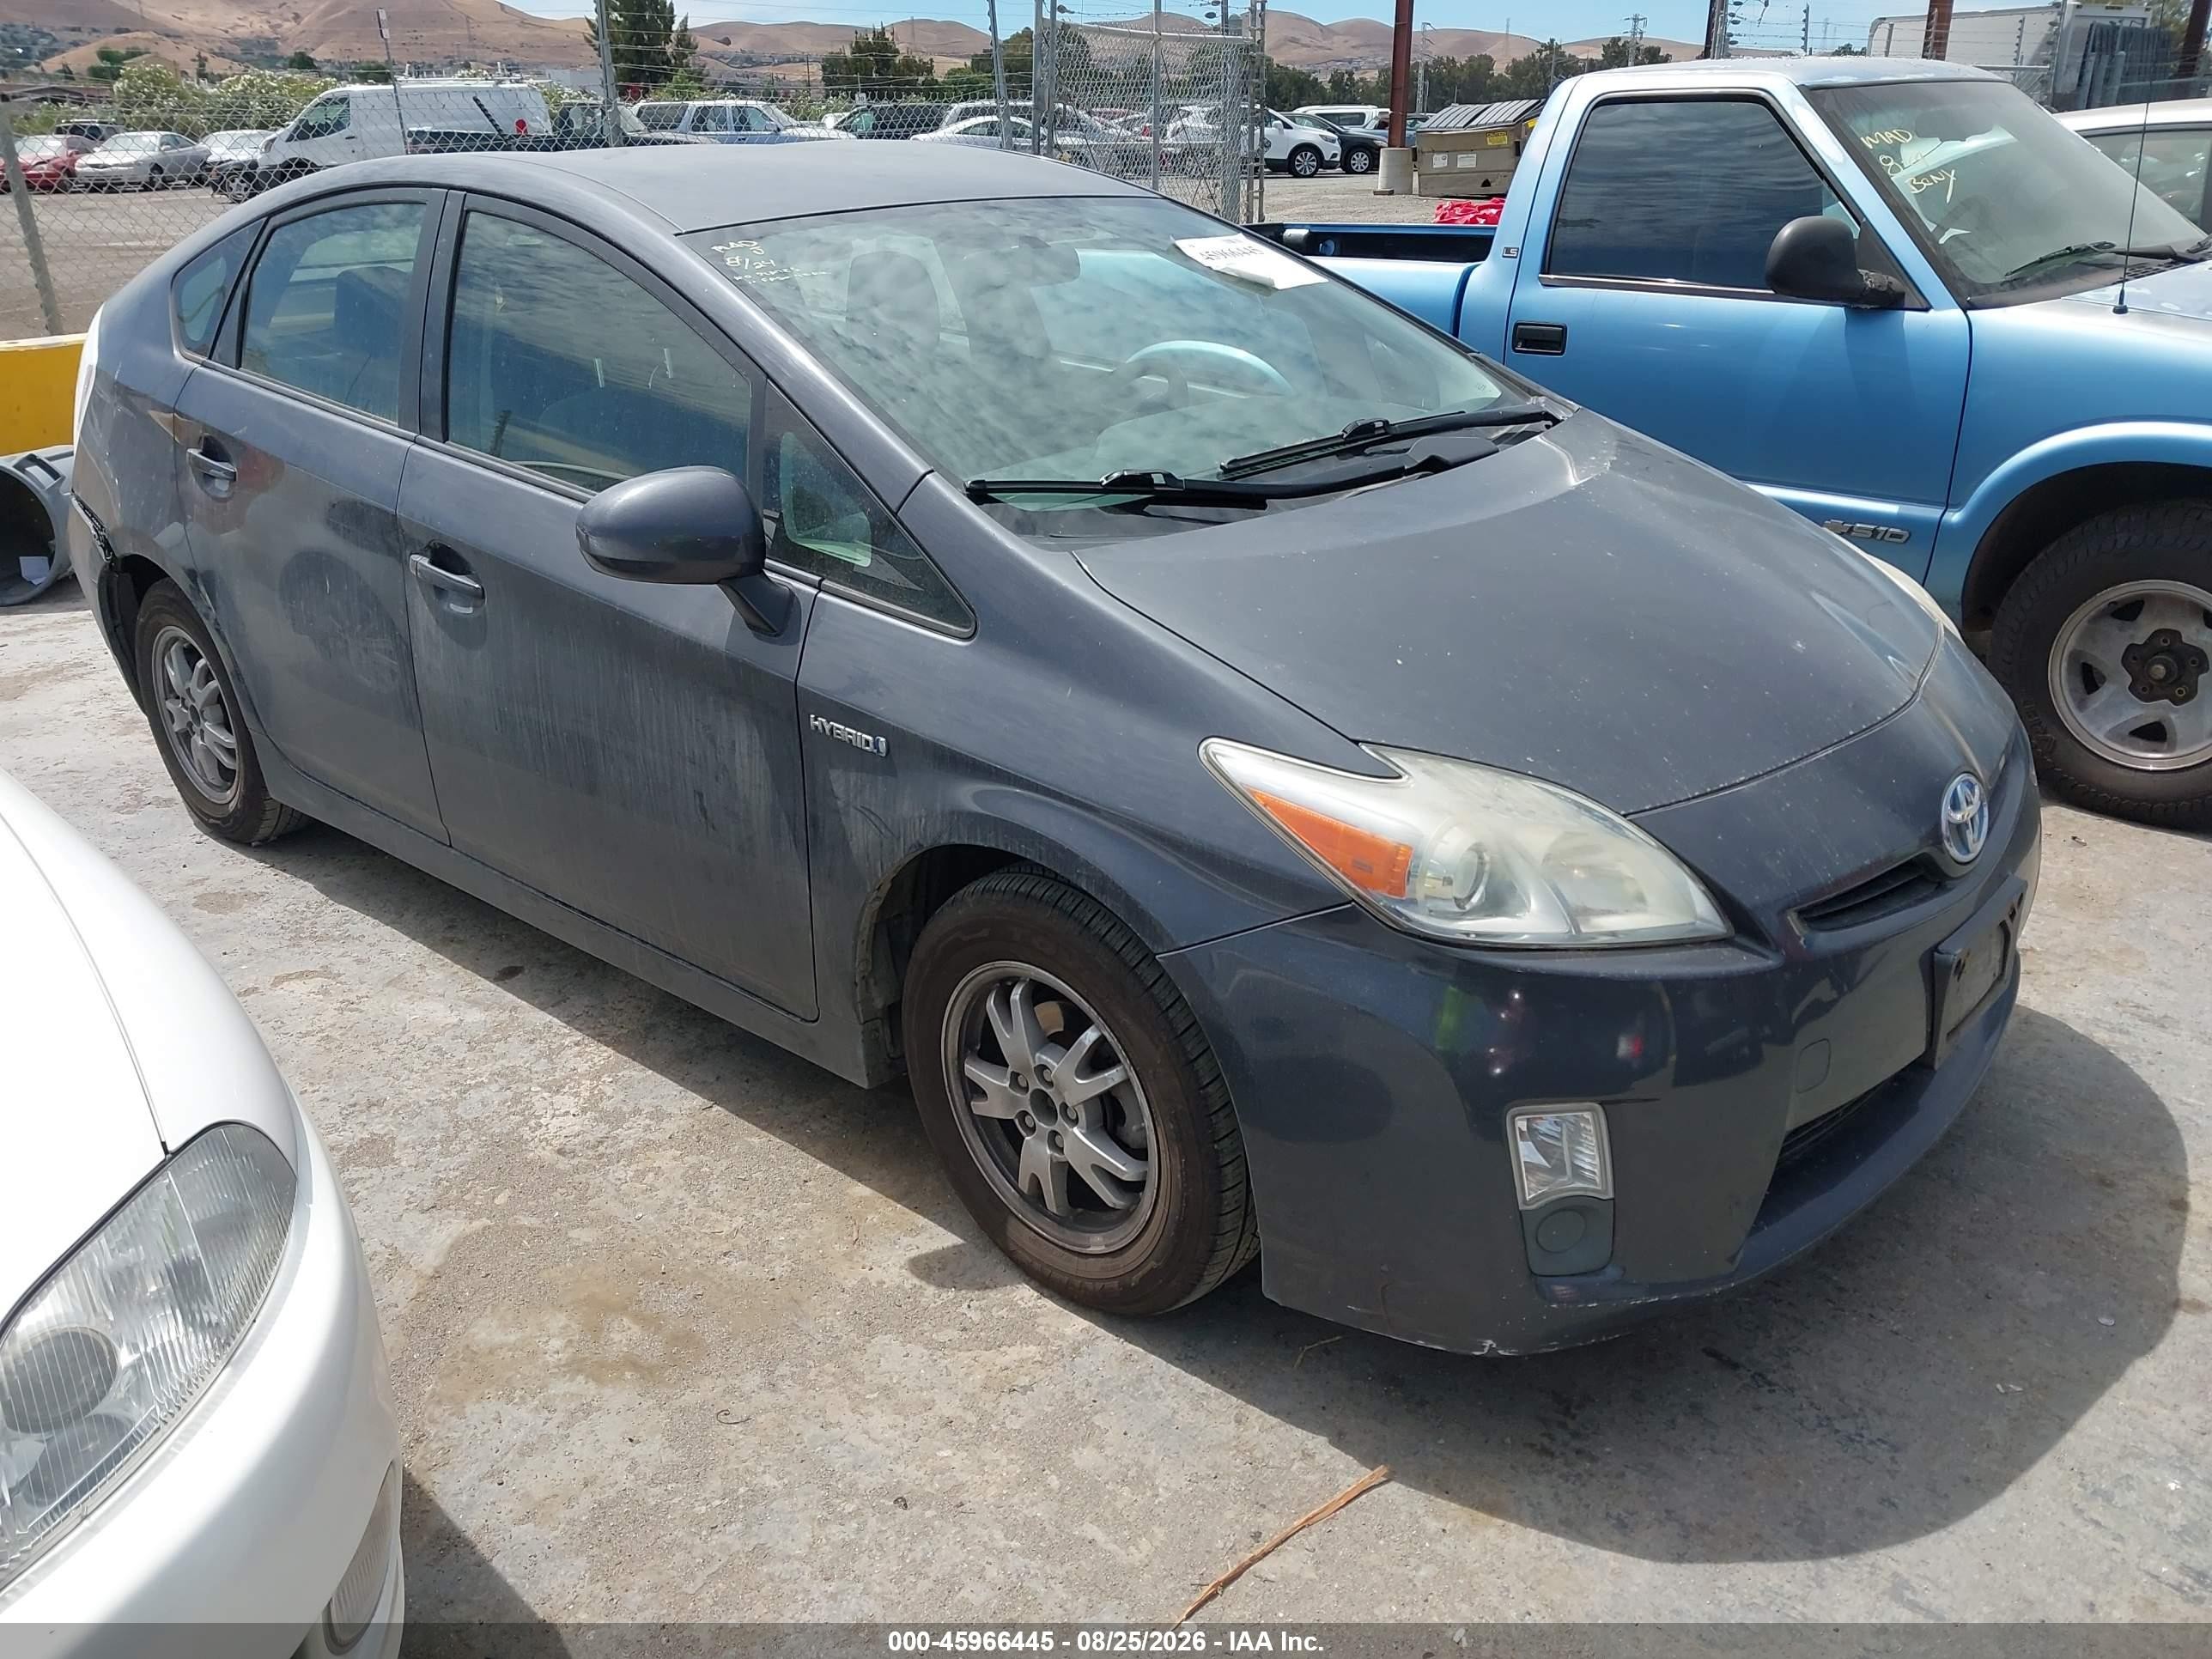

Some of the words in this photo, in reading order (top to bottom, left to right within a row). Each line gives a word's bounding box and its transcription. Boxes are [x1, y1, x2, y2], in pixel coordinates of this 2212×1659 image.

[1860, 129, 1912, 149] MAD
[1504, 248, 1518, 257] LS
[1850, 523, 1911, 544] S10
[810, 714, 874, 752] HYBRID
